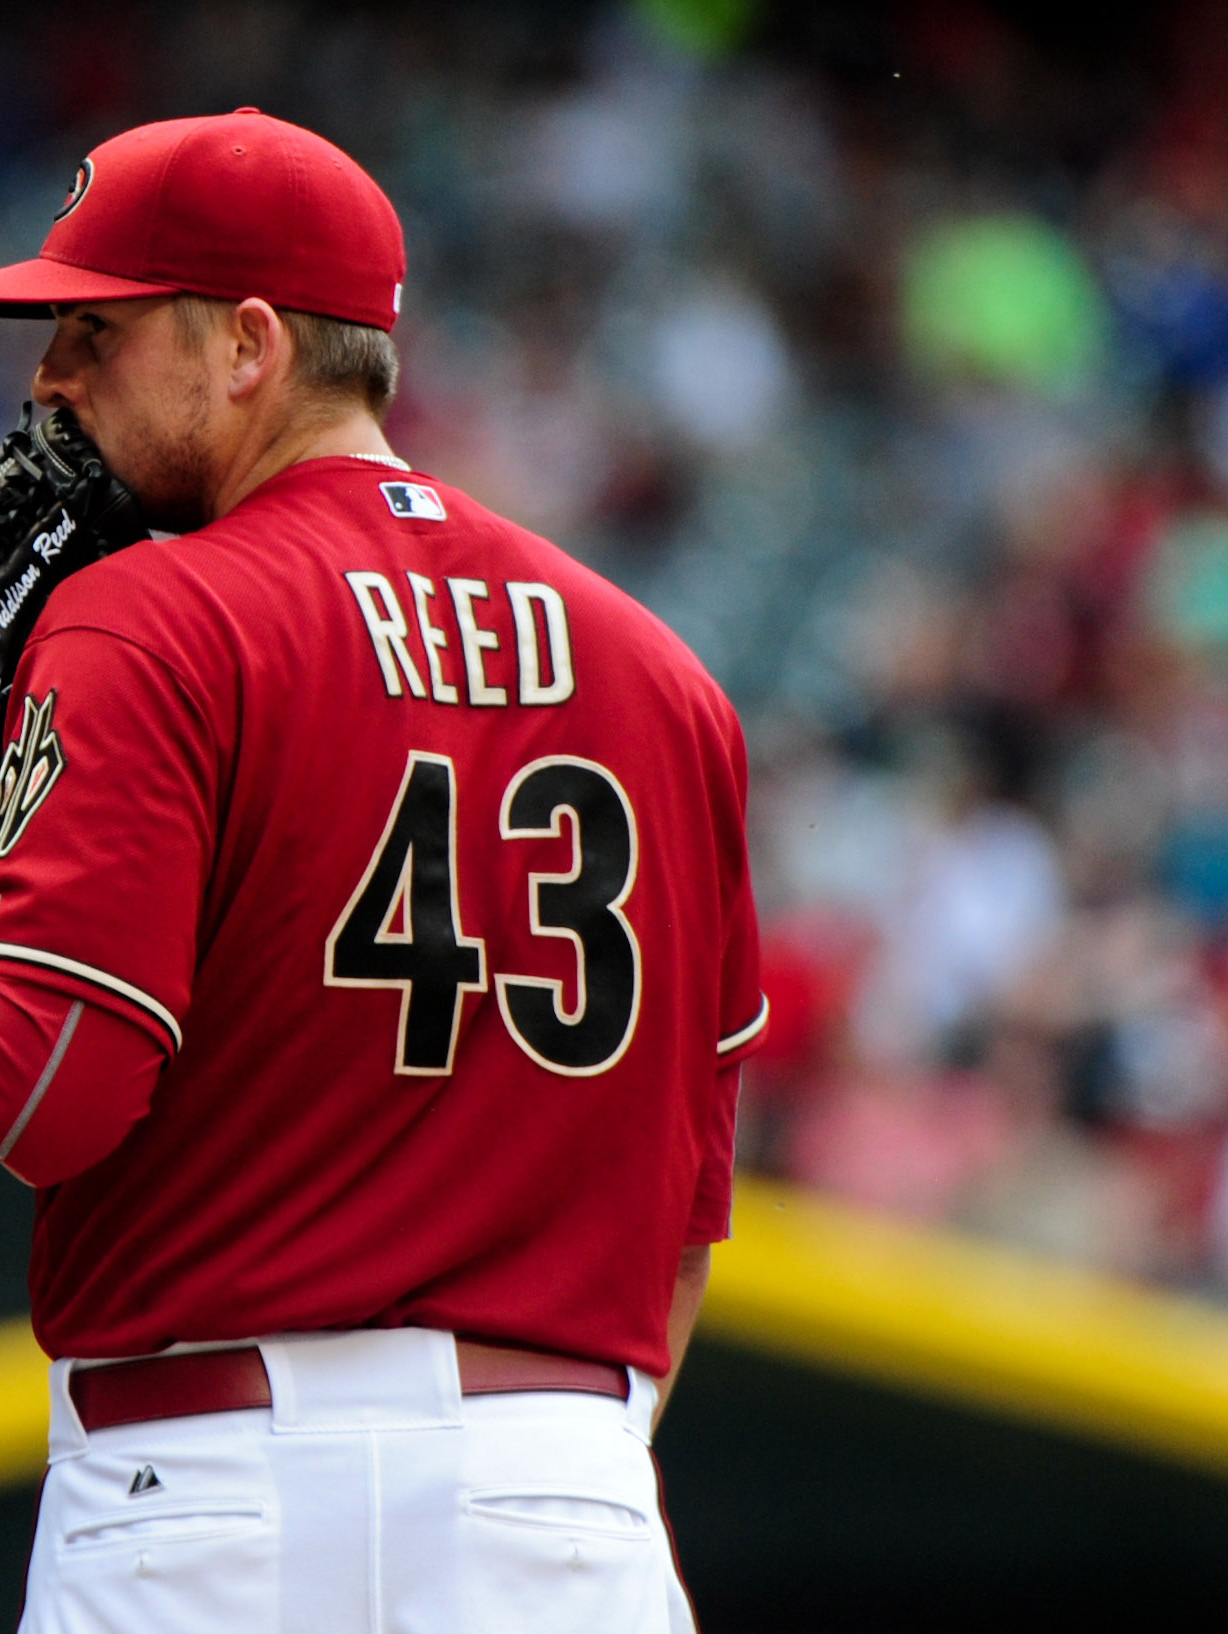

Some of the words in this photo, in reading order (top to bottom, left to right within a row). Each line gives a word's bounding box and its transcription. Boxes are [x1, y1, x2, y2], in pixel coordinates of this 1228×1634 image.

[32, 508, 76, 565] Reed
[343, 570, 576, 707] REED
[323, 749, 643, 1077] 43
